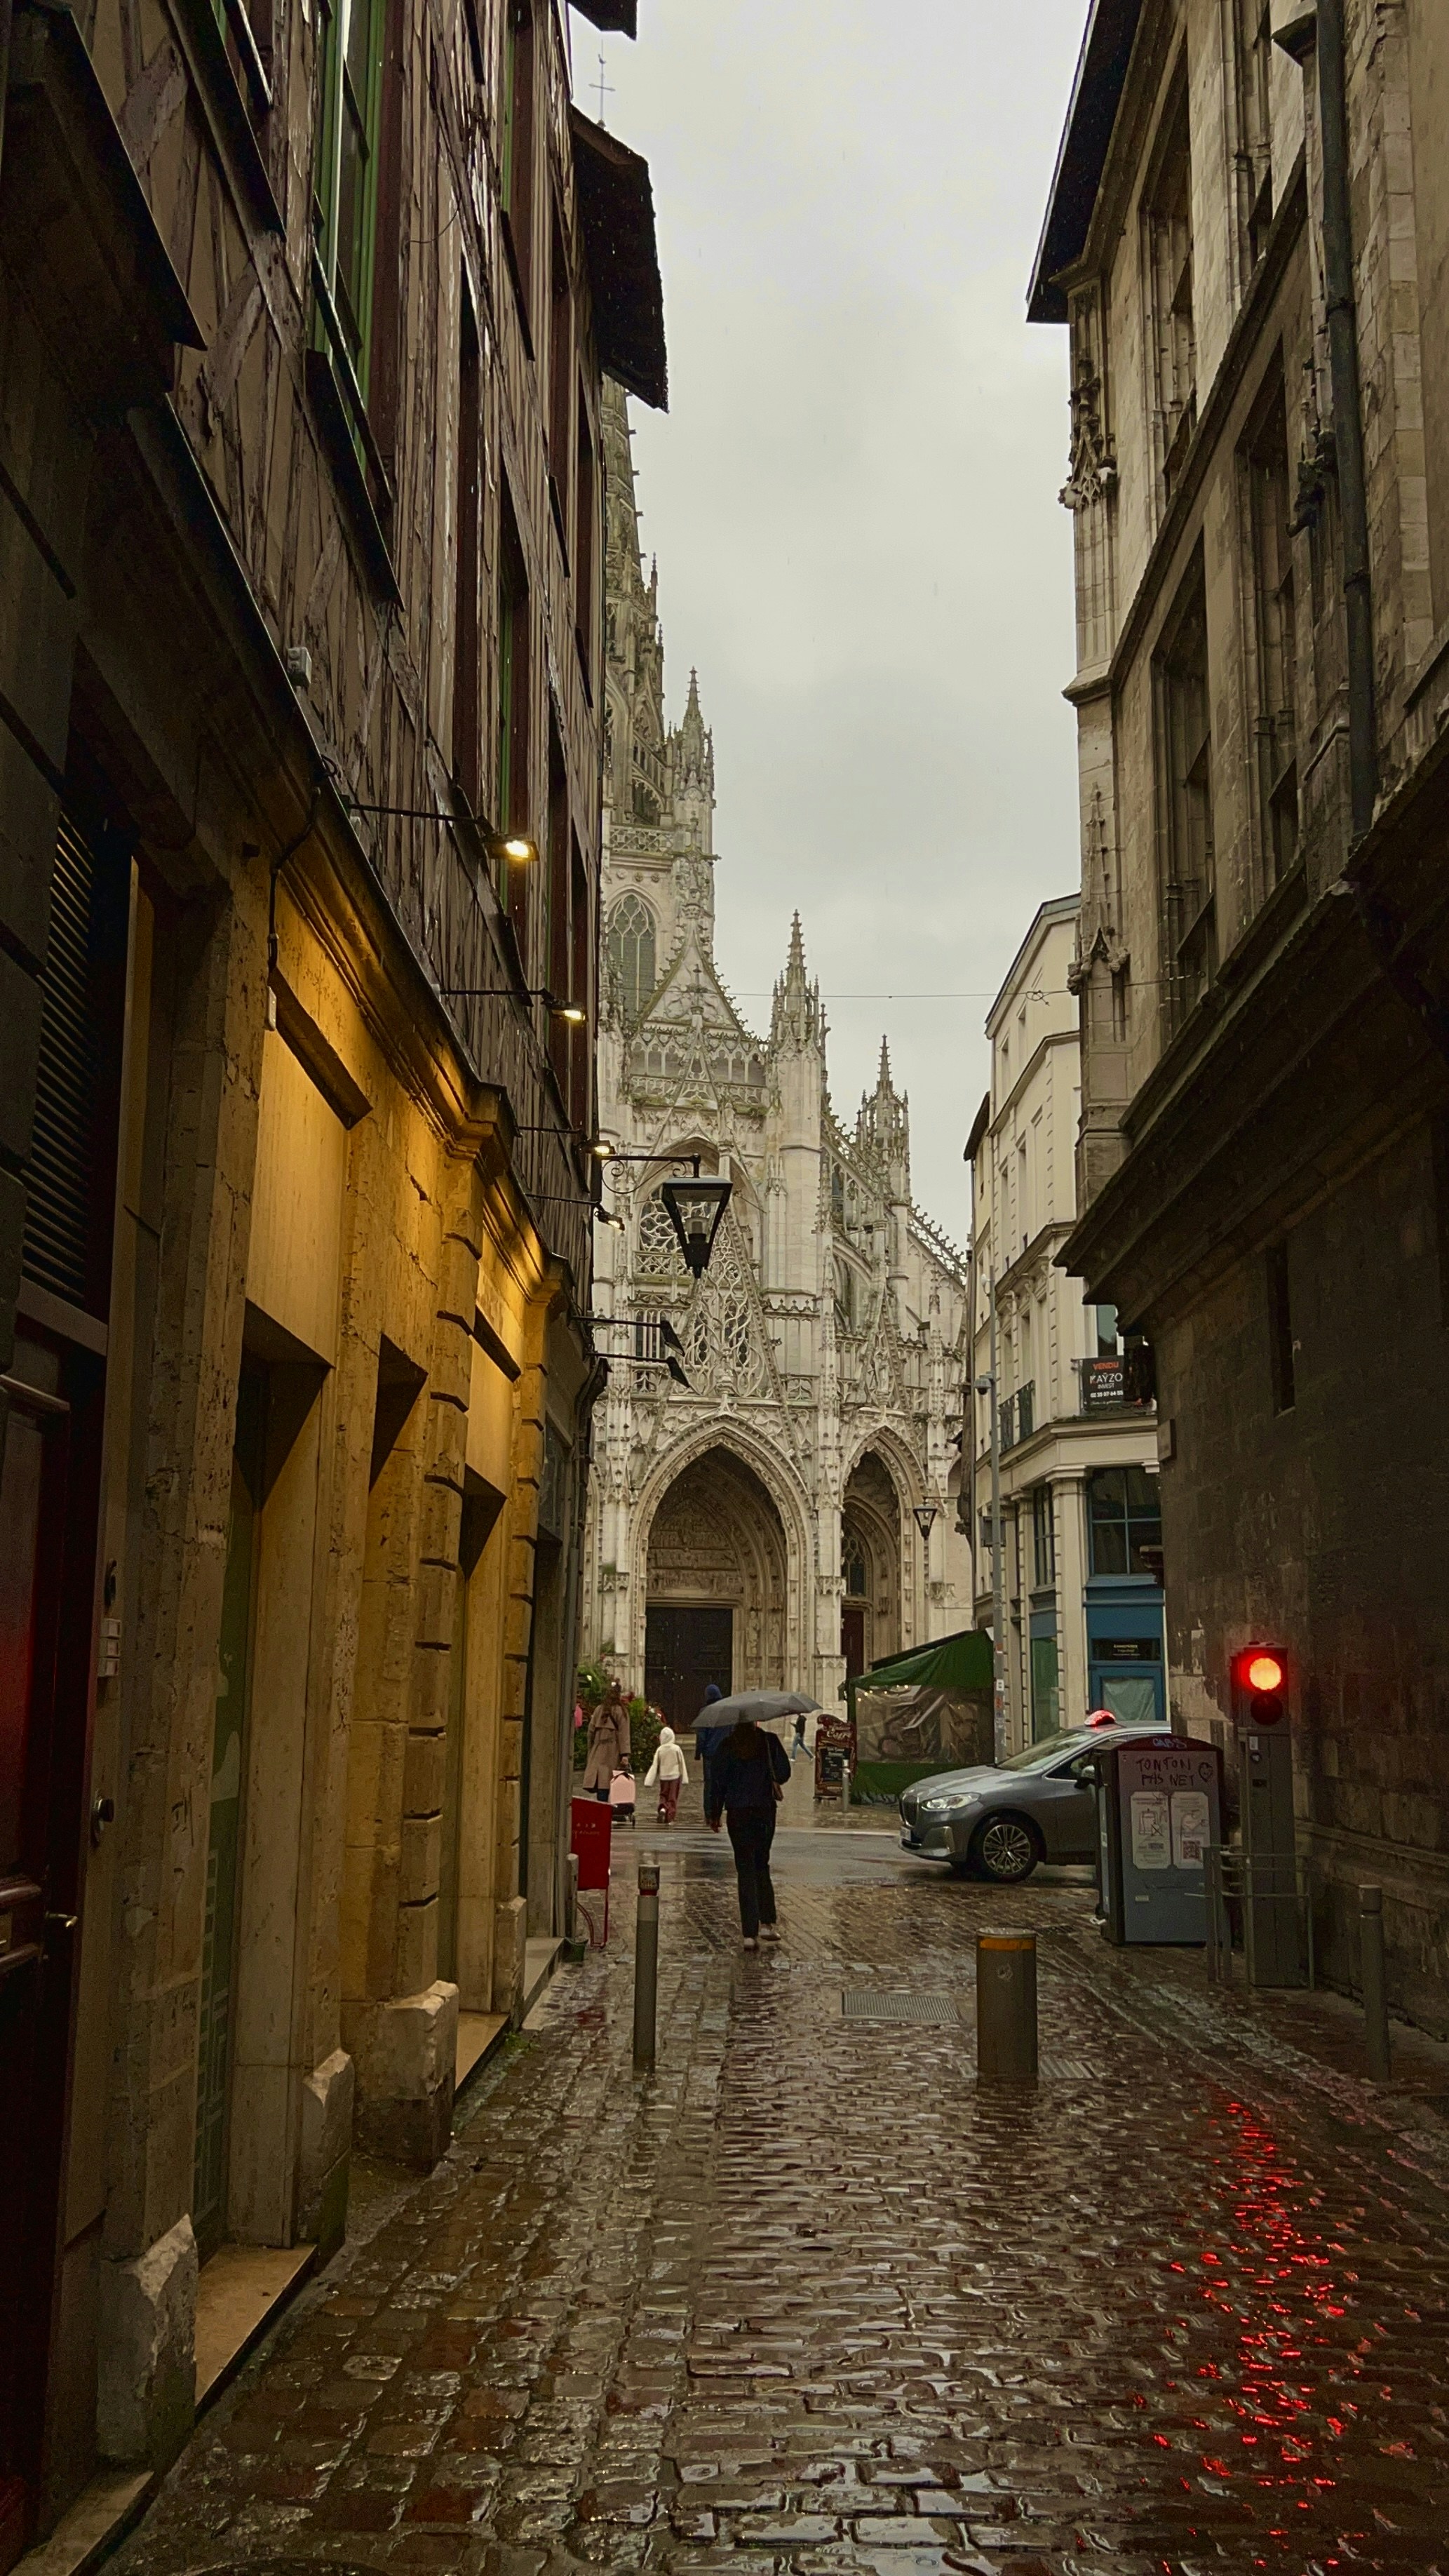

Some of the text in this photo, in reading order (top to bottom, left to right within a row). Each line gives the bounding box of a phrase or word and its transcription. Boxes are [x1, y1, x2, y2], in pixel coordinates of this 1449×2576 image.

[1093, 1362, 1119, 1370] VENDU
[1136, 1756, 1191, 1772] TONTON
[1170, 1773, 1195, 1786] NET
